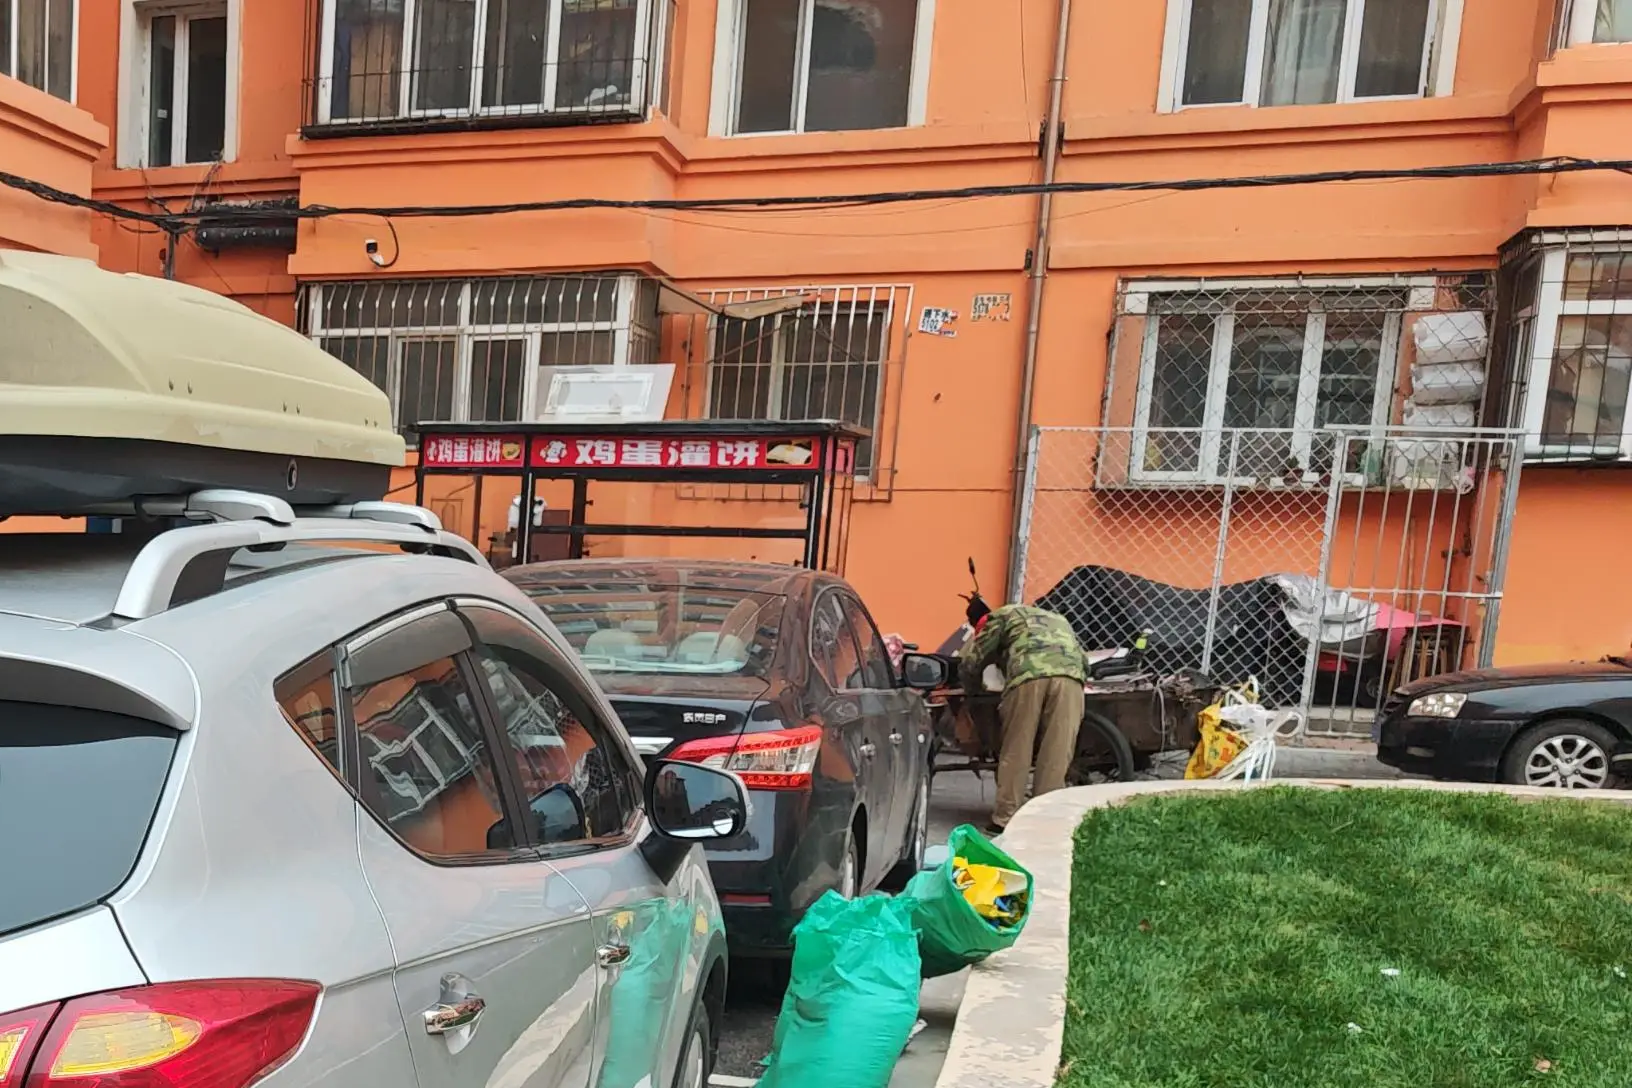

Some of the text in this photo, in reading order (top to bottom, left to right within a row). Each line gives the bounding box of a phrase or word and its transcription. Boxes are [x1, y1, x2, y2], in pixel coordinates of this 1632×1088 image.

[437, 438, 501, 463] 鸡蛋灌饼
[575, 439, 760, 466] 鸡蛋灌饼
